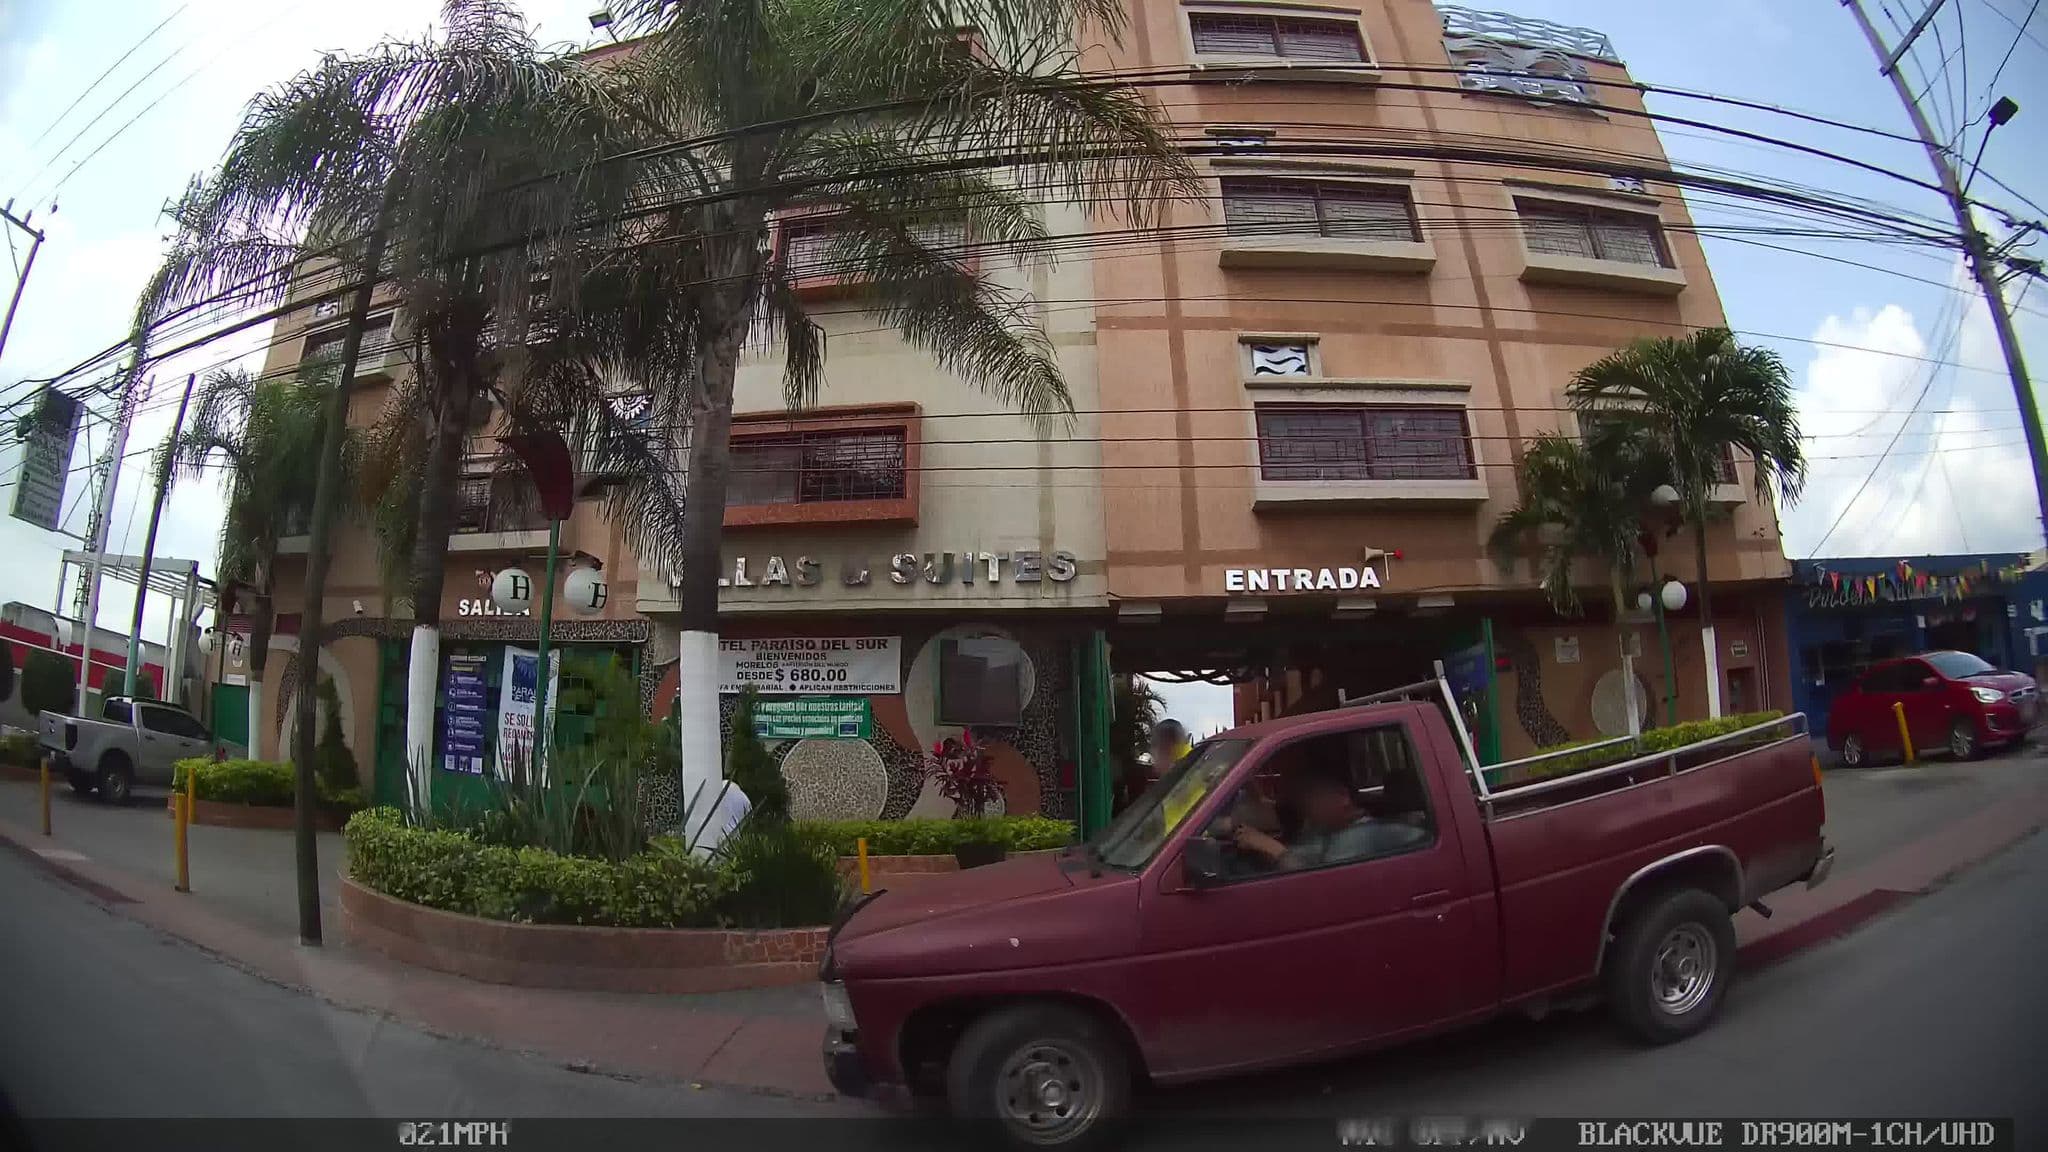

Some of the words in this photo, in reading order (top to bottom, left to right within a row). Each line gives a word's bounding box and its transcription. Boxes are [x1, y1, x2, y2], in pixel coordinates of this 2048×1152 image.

[890, 549, 1078, 588] SUITES
[1225, 566, 1381, 592] ENTRADA
[510, 574, 530, 600] H
[820, 639, 851, 650] DEL
[856, 638, 889, 650] SUR
[755, 652, 828, 661] BIENVENIDOS
[735, 661, 780, 669] MORELOS
[736, 672, 773, 680] DESDE
[774, 668, 785, 682] $
[790, 668, 848, 682] 680.00
[504, 711, 516, 726] SE
